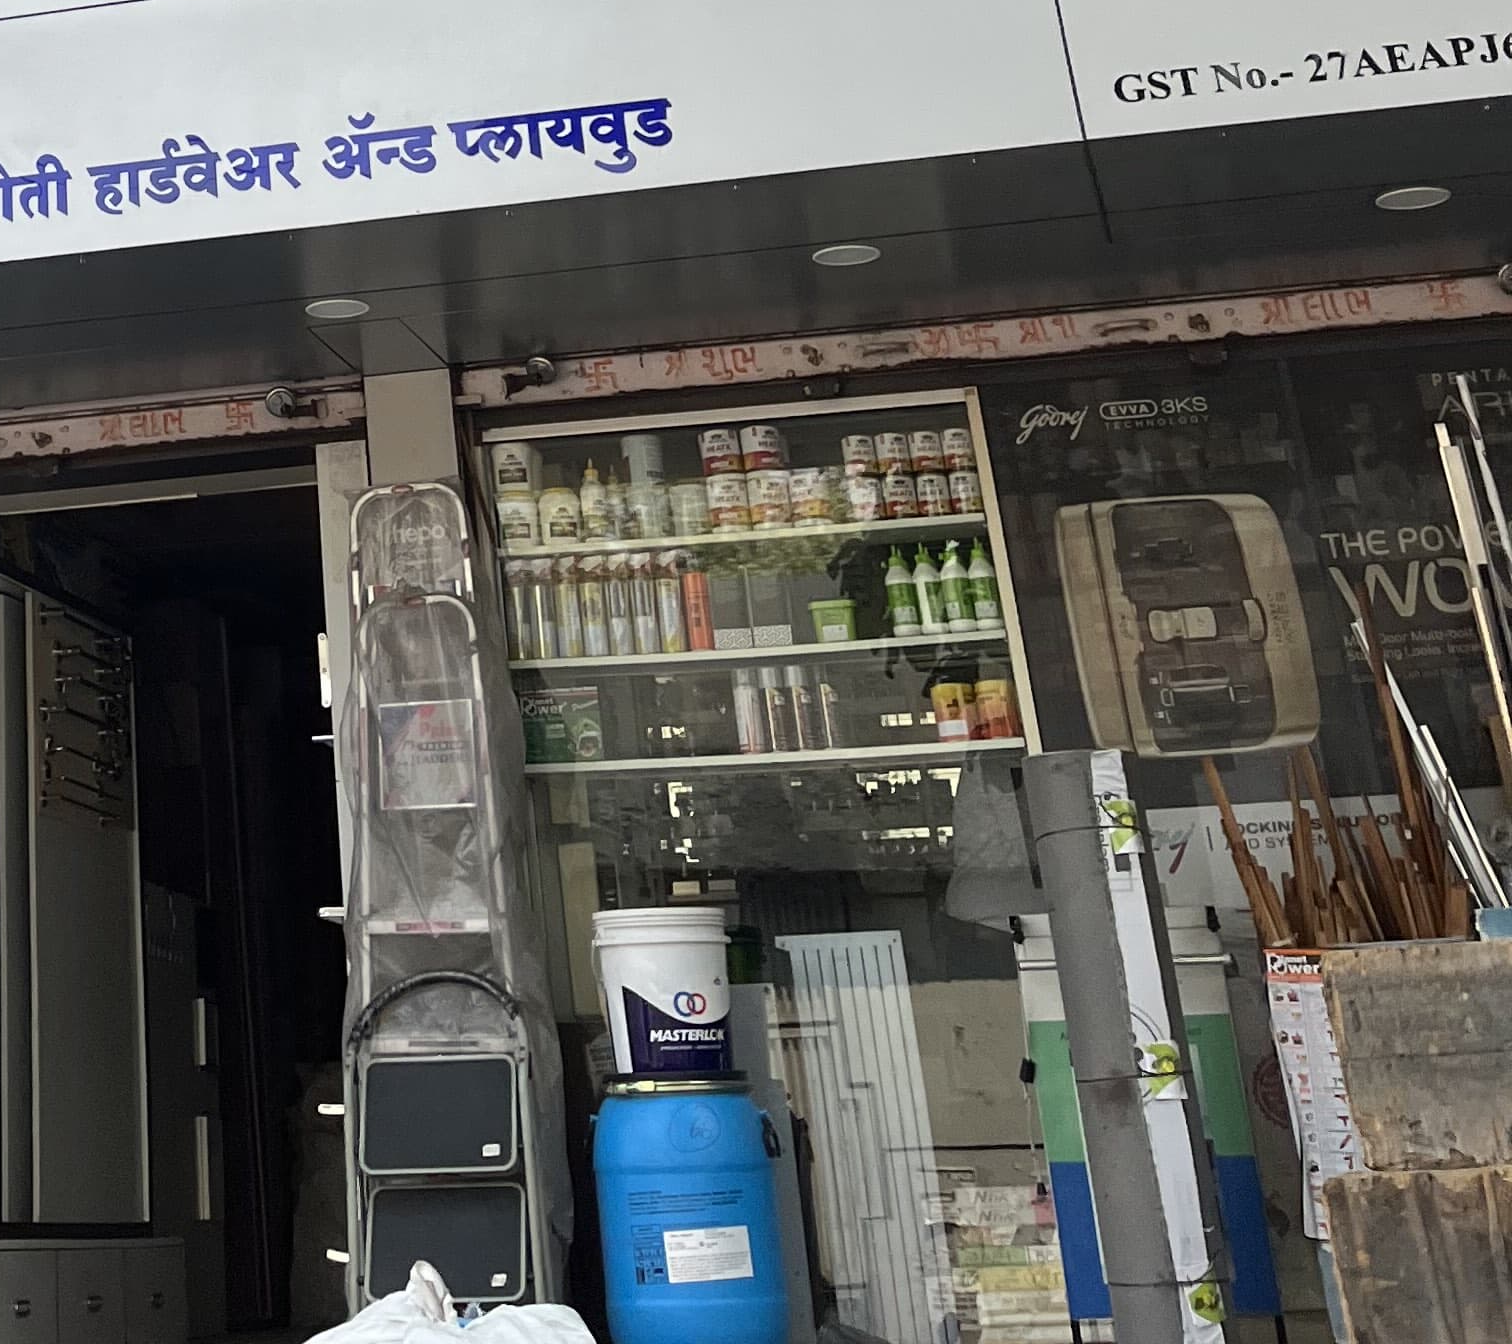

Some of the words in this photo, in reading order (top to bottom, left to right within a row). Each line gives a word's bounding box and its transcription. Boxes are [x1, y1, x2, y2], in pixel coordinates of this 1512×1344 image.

[1113, 66, 1200, 104] GST
[87, 132, 301, 217] हार्डवेअर
[446, 97, 676, 175] प्लायवुड
[1160, 395, 1209, 415] 3KS
[1319, 528, 1390, 560] THE
